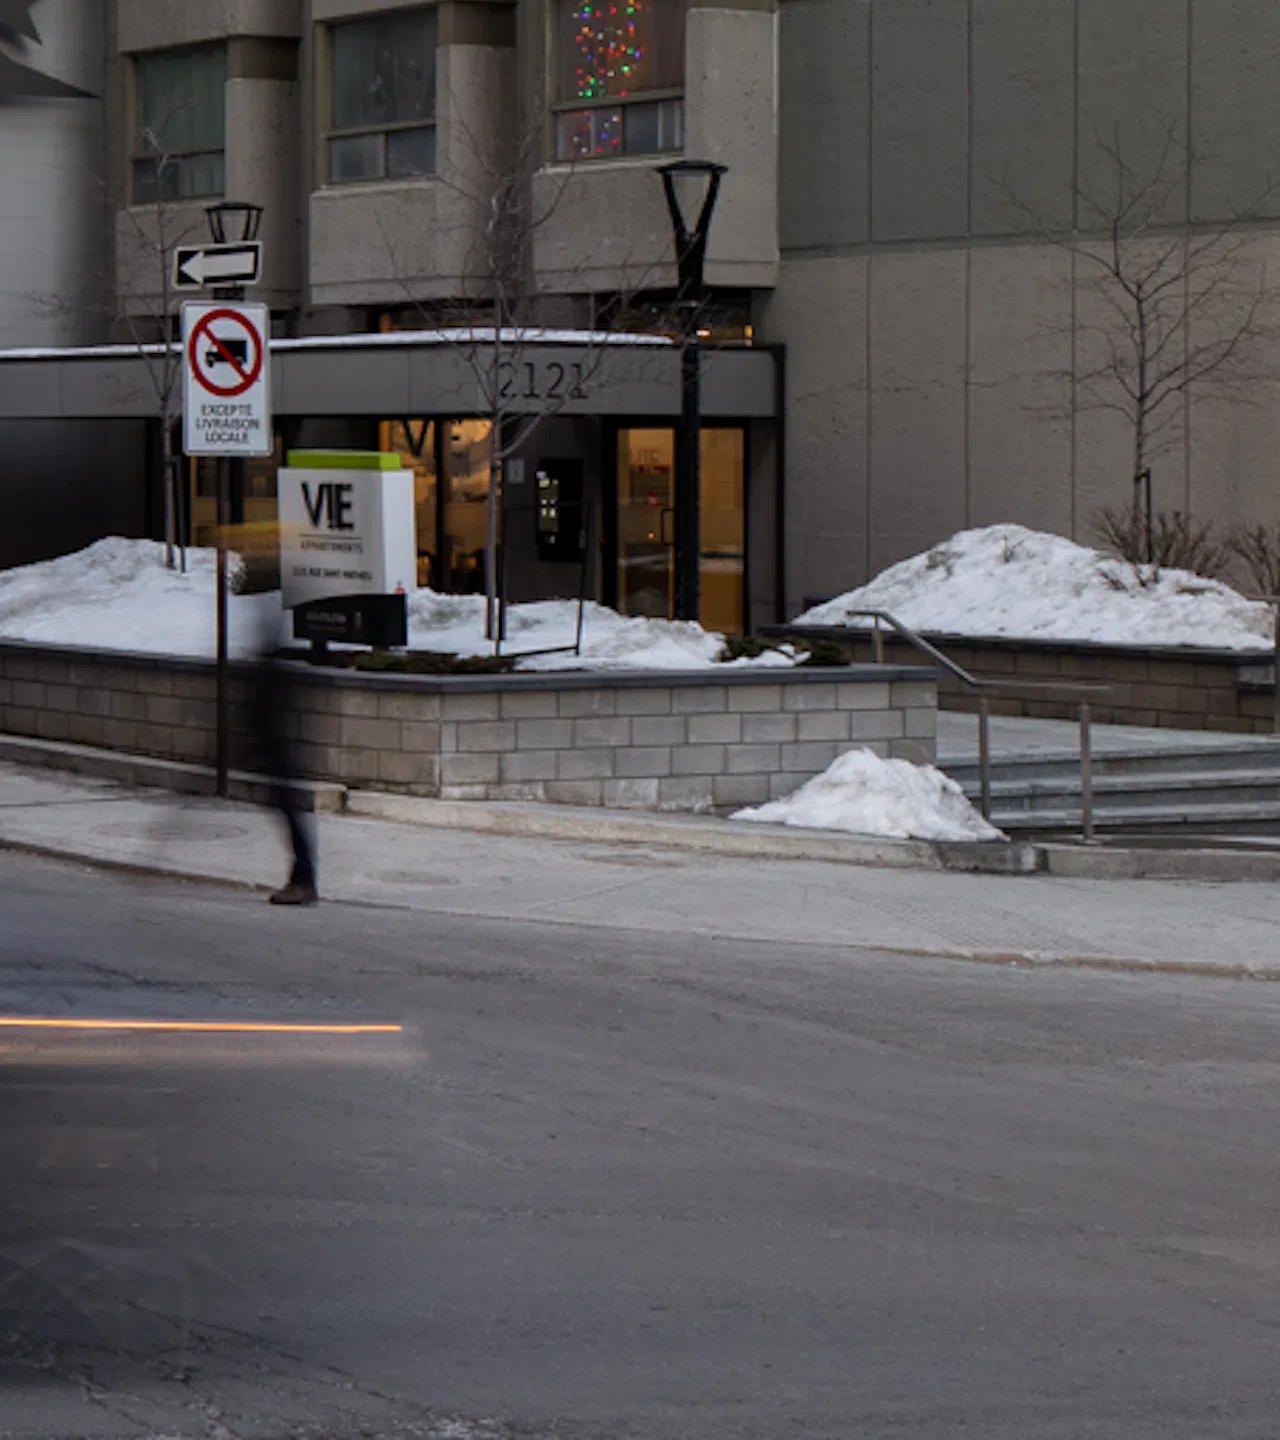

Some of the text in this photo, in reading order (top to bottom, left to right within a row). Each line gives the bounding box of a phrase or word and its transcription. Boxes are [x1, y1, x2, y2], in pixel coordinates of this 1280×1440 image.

[498, 361, 589, 399] 2121
[195, 417, 260, 430] LIVRAISON
[204, 430, 251, 444] LOCALE
[301, 481, 355, 531] VIE
